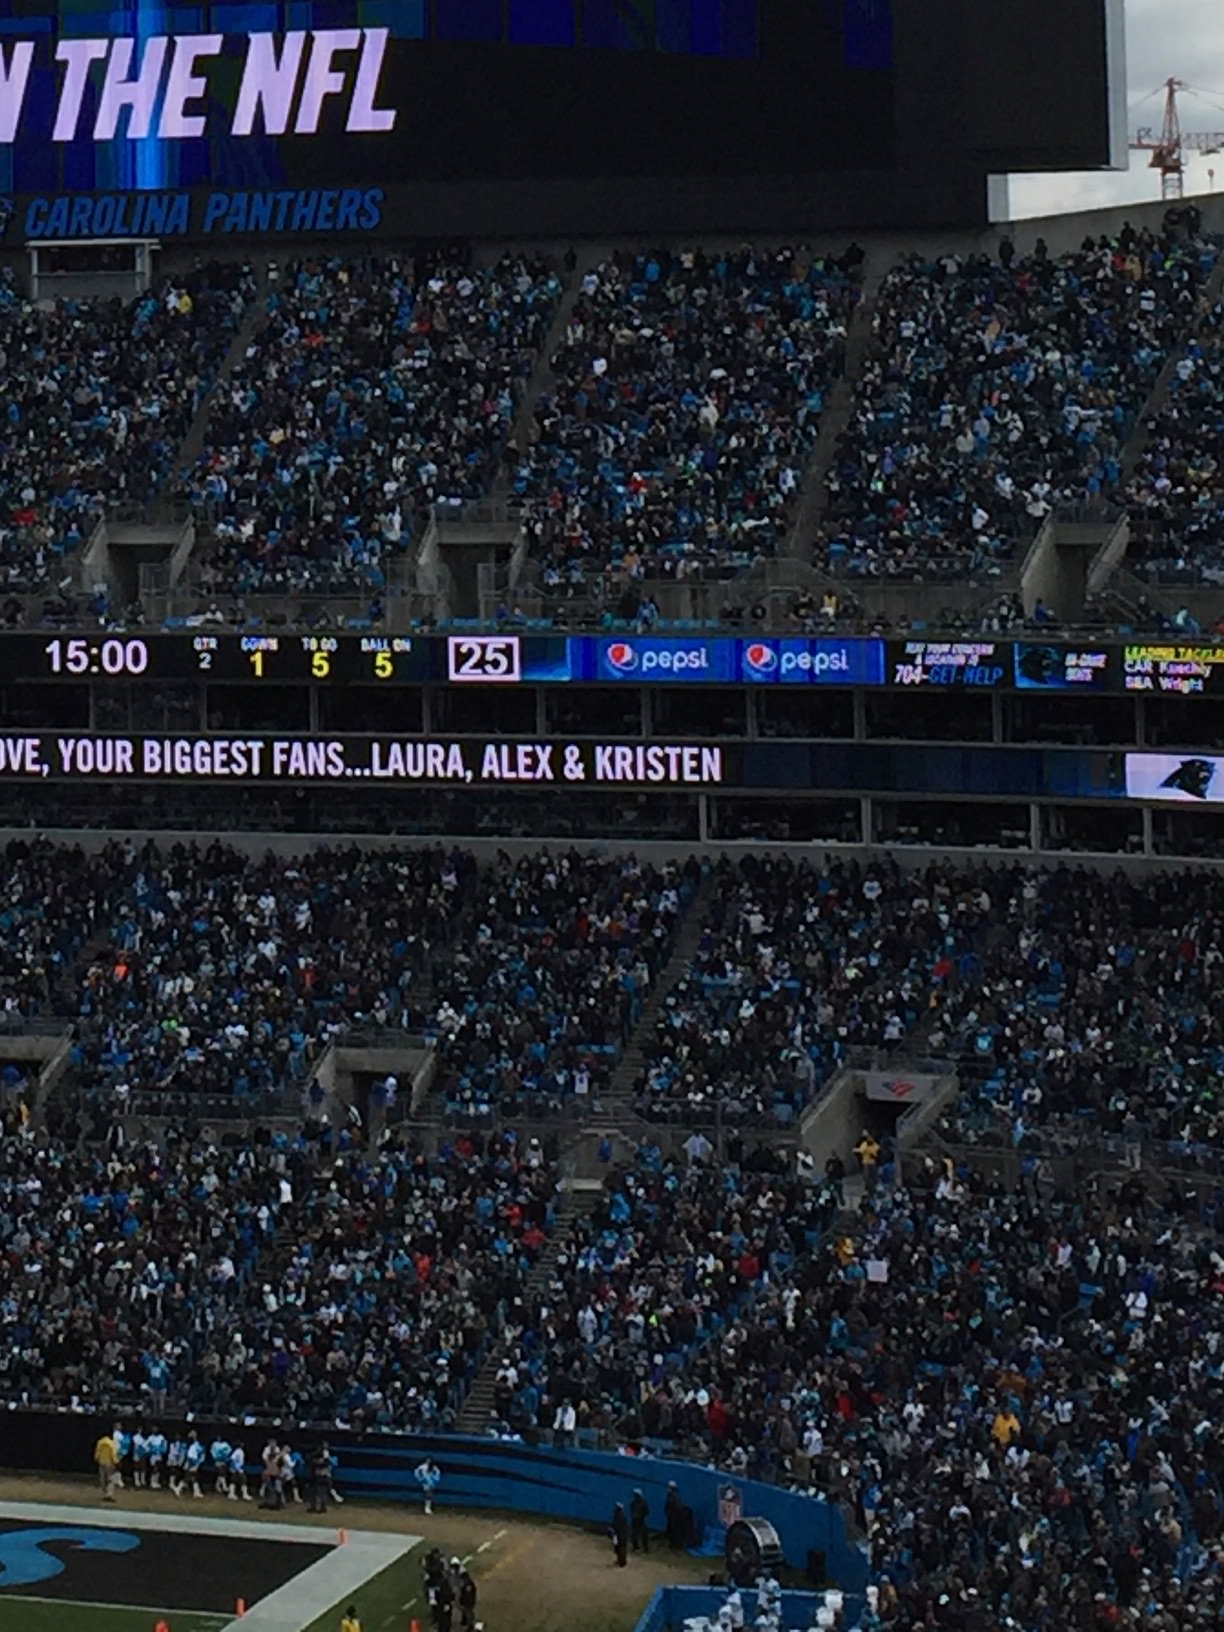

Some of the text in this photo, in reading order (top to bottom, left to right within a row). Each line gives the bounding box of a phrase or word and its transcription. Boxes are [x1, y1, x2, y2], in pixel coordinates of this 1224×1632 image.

[52, 34, 224, 141] THE
[231, 28, 397, 136] NFL
[25, 189, 385, 238] CAROLINA PANTHERS
[45, 640, 148, 674] 15:00
[199, 652, 212, 669] 2
[249, 652, 263, 677] 1
[311, 652, 330, 678] 5
[374, 652, 393, 678] 5
[459, 642, 508, 674] 25
[642, 647, 708, 671] pepsi
[781, 648, 849, 674] pepsi
[58, 738, 134, 773] YOUR
[143, 739, 264, 776] BIGGEST
[481, 744, 554, 780] ALEX
[563, 745, 585, 780] &
[595, 745, 722, 782] KRISTEN
